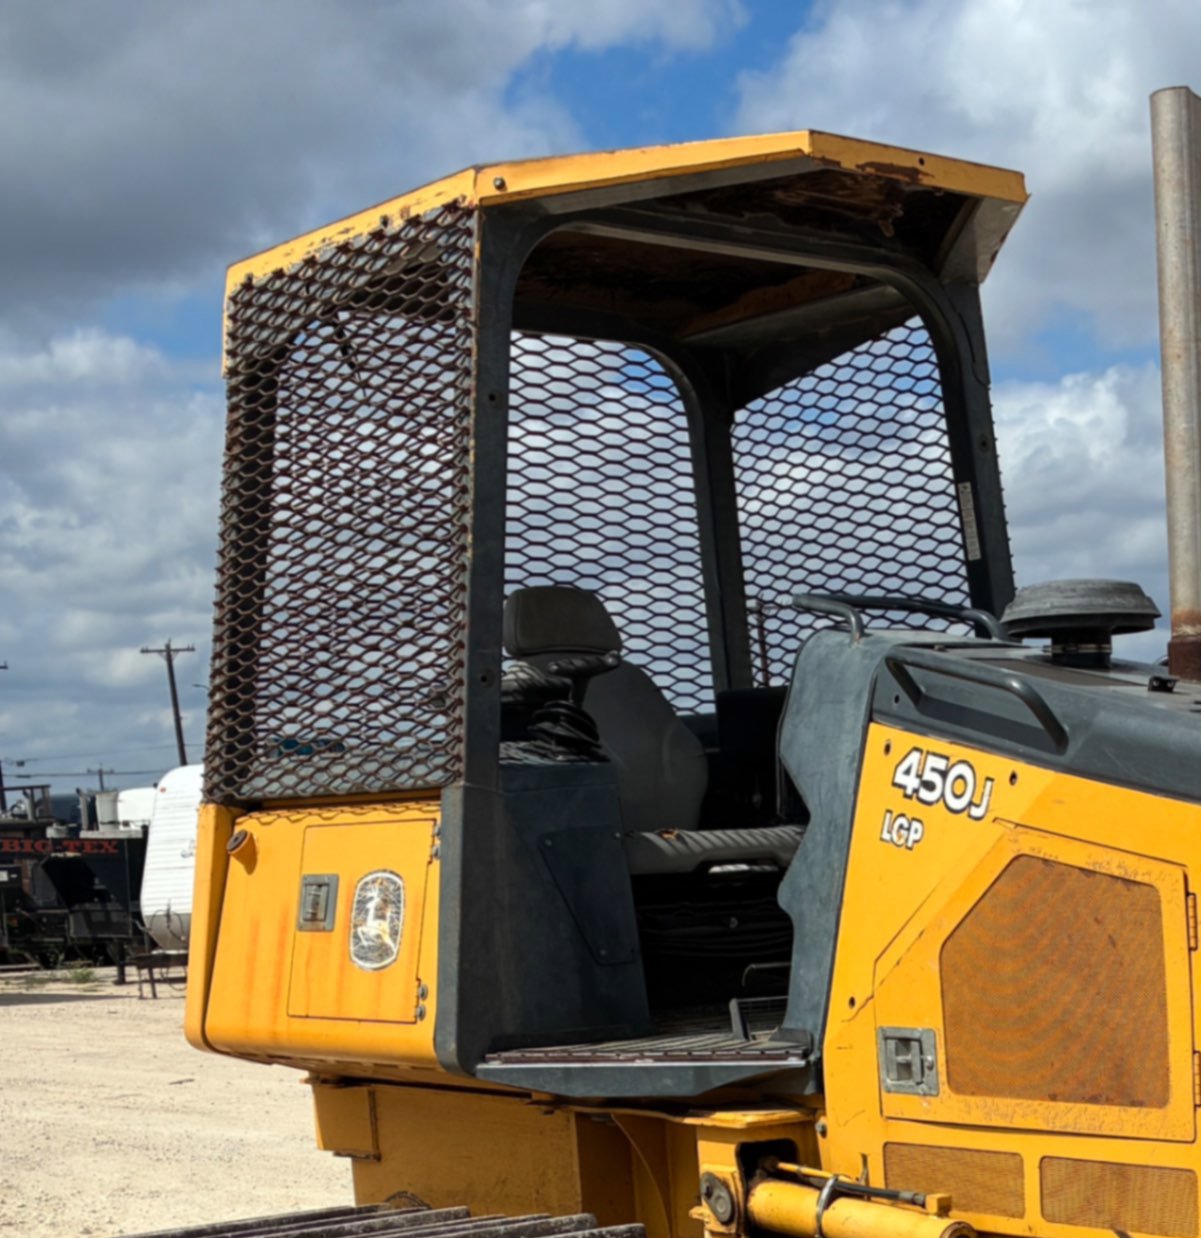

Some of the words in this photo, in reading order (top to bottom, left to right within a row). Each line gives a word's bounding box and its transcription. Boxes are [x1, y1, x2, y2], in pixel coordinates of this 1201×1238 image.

[892, 746, 995, 821] 450J
[62, 840, 119, 854] TEX
[880, 808, 924, 851] LGP
